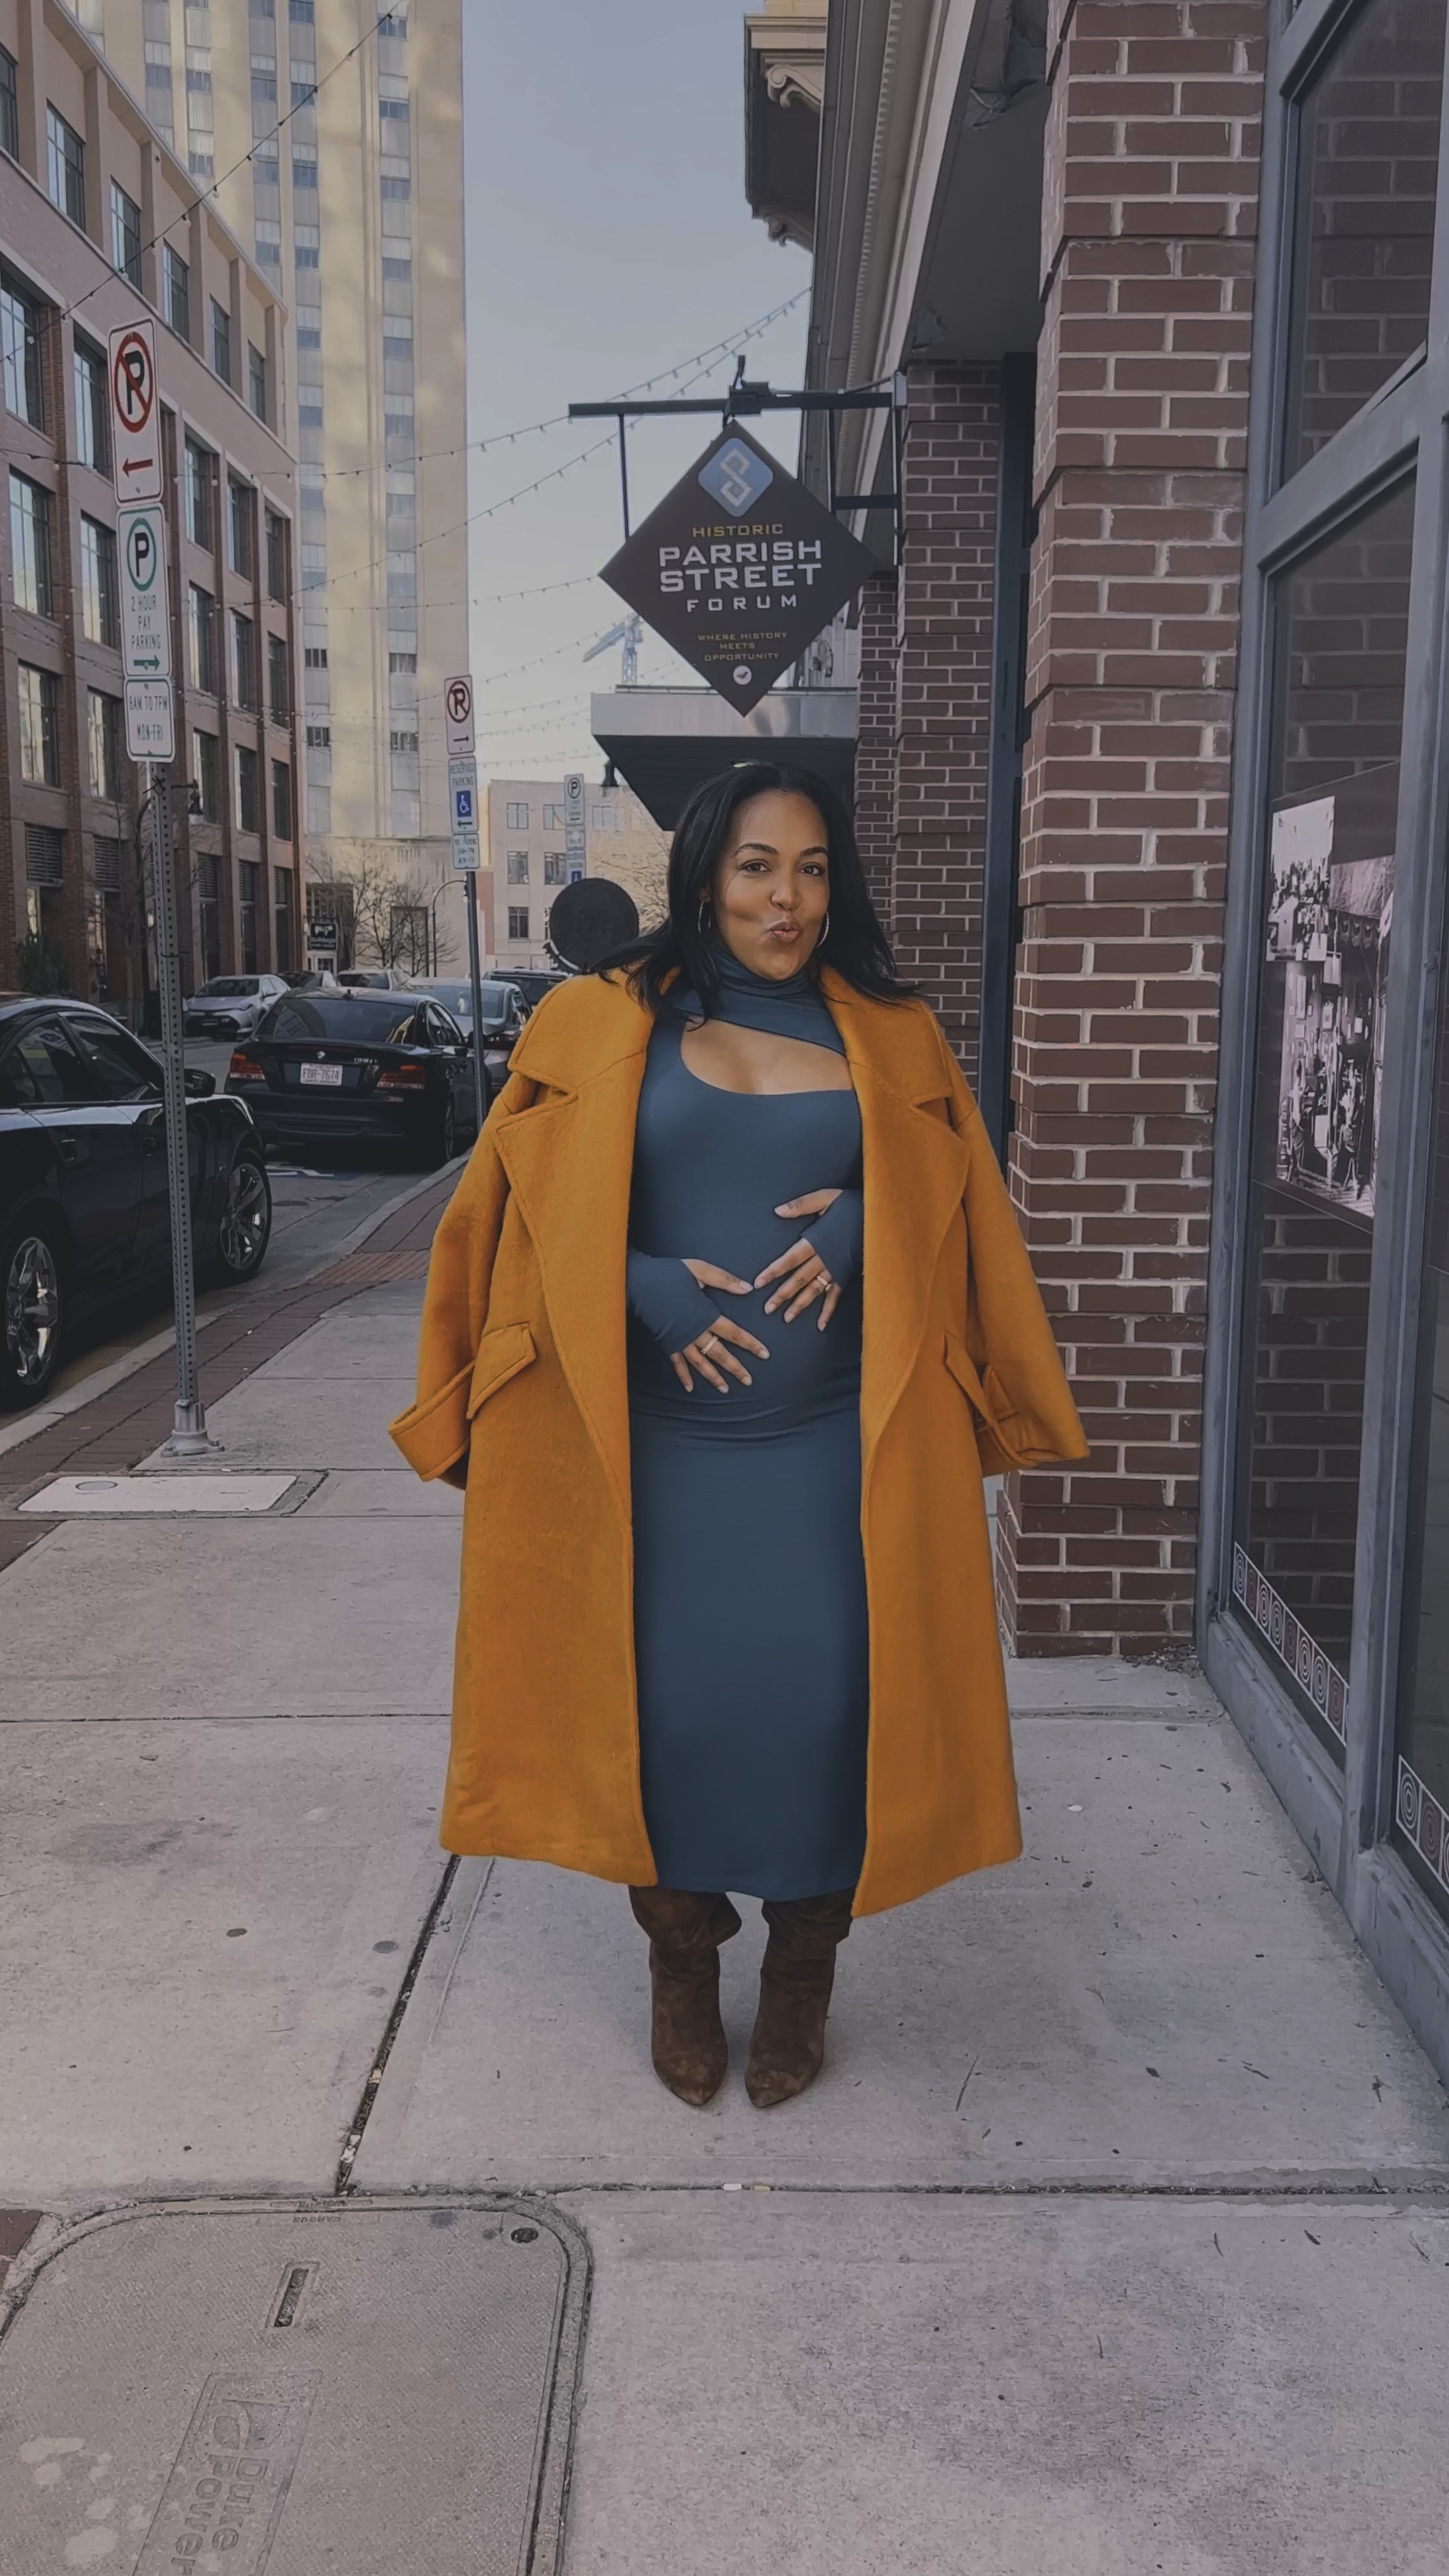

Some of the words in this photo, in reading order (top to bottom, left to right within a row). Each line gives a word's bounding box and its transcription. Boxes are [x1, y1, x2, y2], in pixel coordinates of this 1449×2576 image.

[692, 524, 784, 537] HISTORIC
[135, 532, 150, 578] P
[659, 539, 822, 567] PARRISH
[660, 563, 822, 592] STREET
[131, 596, 136, 612] 2
[138, 594, 157, 610] HOUR
[686, 594, 797, 612] FORUM
[138, 614, 152, 631] PAY
[131, 634, 161, 650] PARKING
[740, 632, 788, 640] HISTORY
[704, 653, 779, 661] OPPORTUNITY
[129, 696, 142, 710] 8AM
[144, 695, 153, 710] TO
[154, 695, 168, 710] 7PM
[136, 724, 163, 741] MON-FRI
[571, 782, 578, 794] P
[212, 2457, 270, 2551] Duke
[171, 2454, 236, 2575] Power
